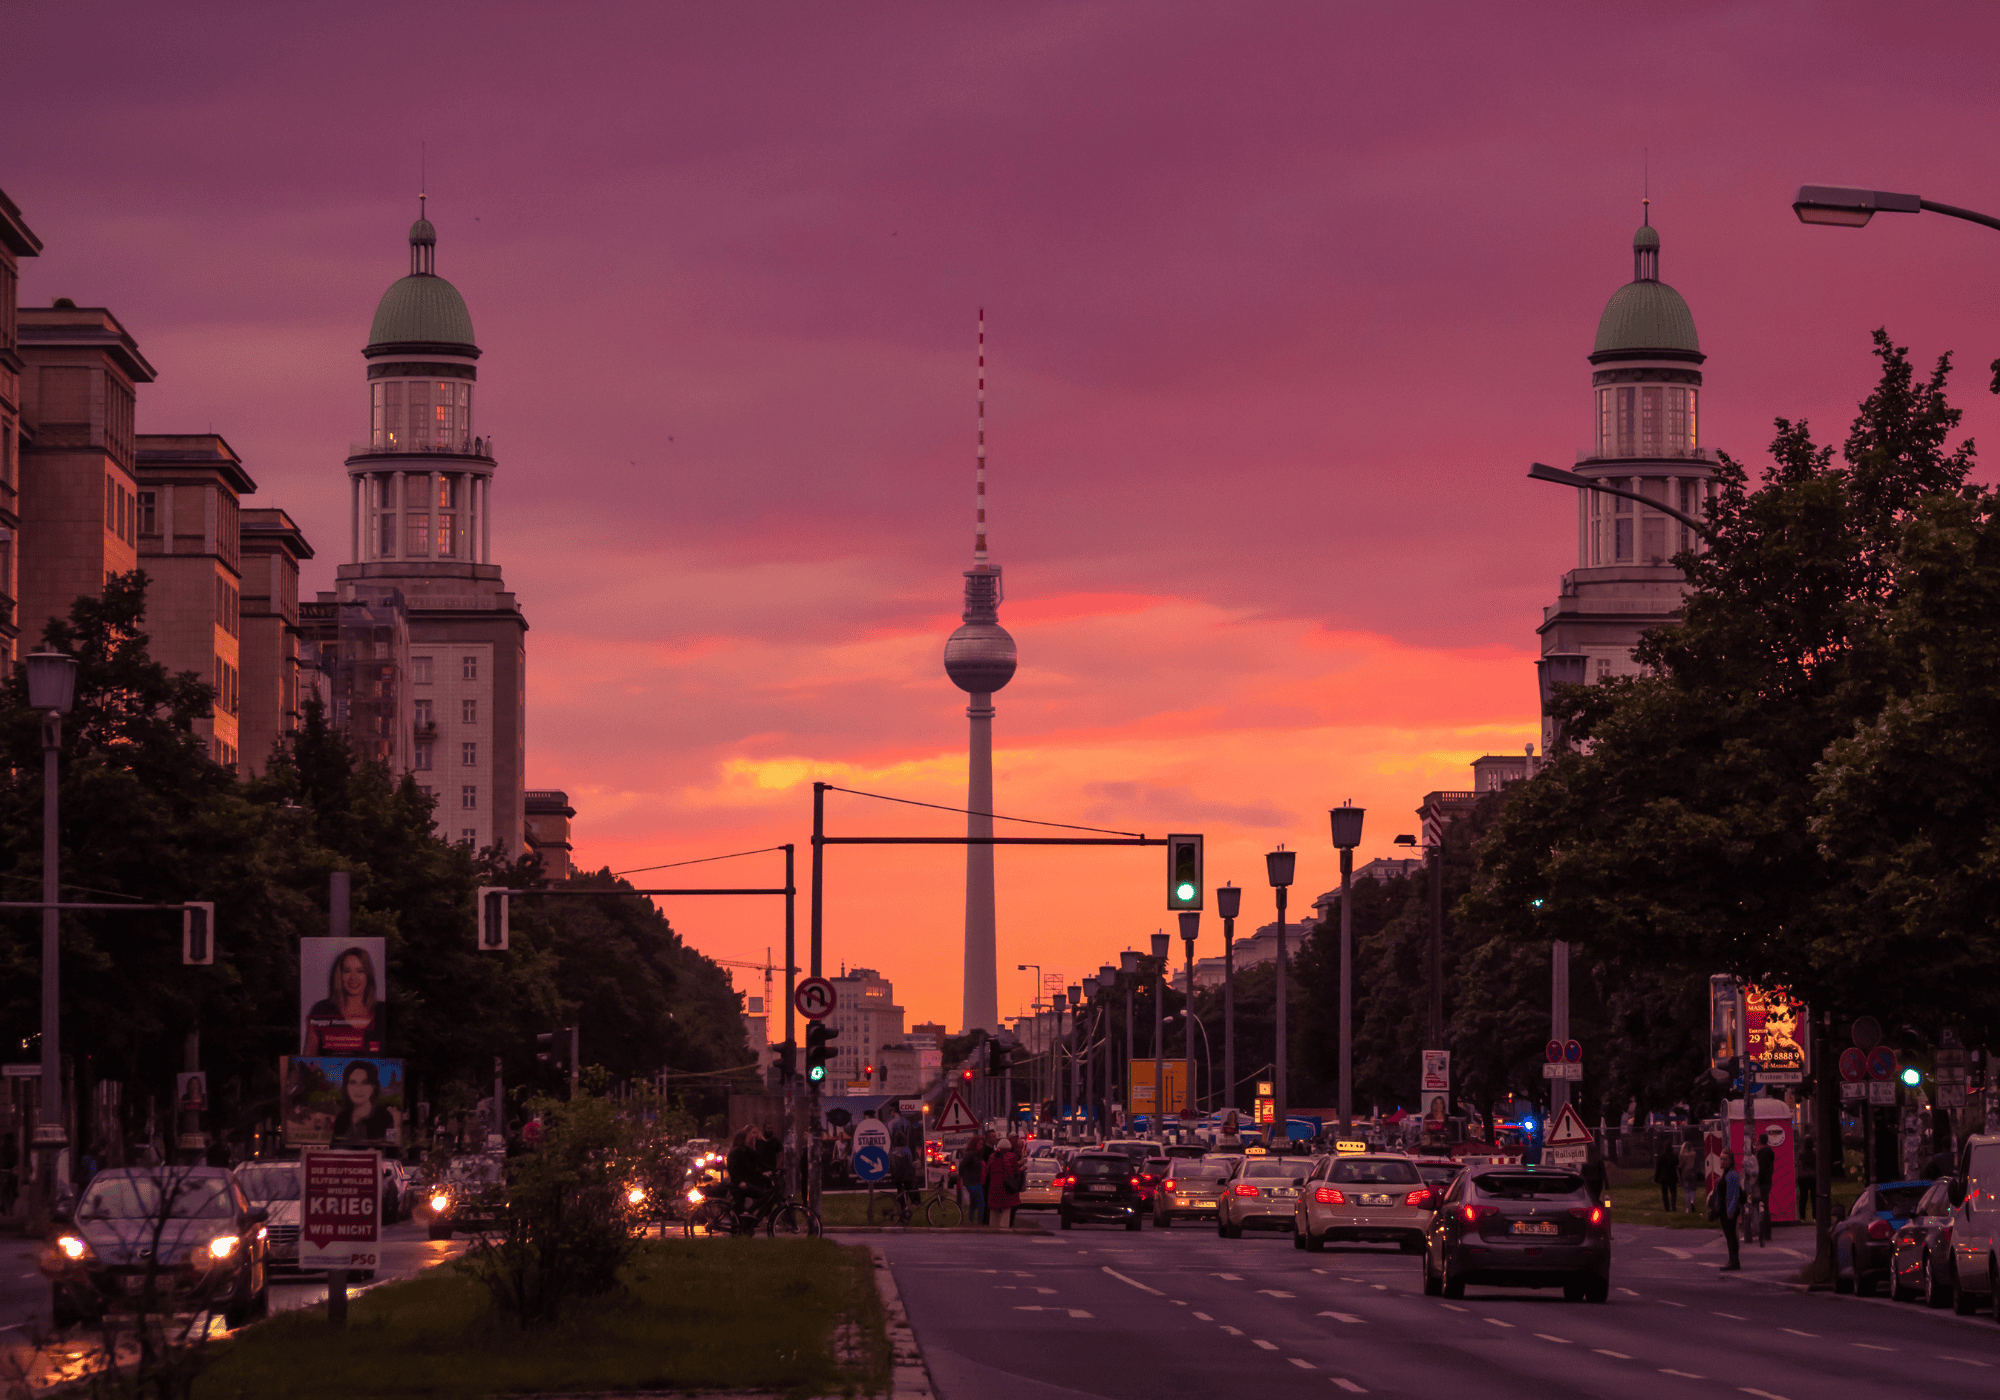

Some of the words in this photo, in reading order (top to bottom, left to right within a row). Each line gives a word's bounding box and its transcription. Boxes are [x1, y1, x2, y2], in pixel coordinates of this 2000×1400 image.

[1748, 1034, 1761, 1043] 29
[1759, 1052, 1773, 1060] 420
[1773, 1052, 1793, 1060] 8888
[1794, 1052, 1800, 1060] 9
[858, 1136, 886, 1146] STARKES
[1555, 1149, 1585, 1161] Rollsplitt
[311, 1167, 325, 1175] DIE
[326, 1167, 373, 1175] DEUTSCHEN
[310, 1177, 340, 1185] ELITEN
[327, 1187, 359, 1195] WIEDER
[310, 1197, 374, 1216] KRIEG
[309, 1224, 334, 1235] WIR
[337, 1224, 374, 1235] NICHT
[351, 1254, 376, 1265] PSG
